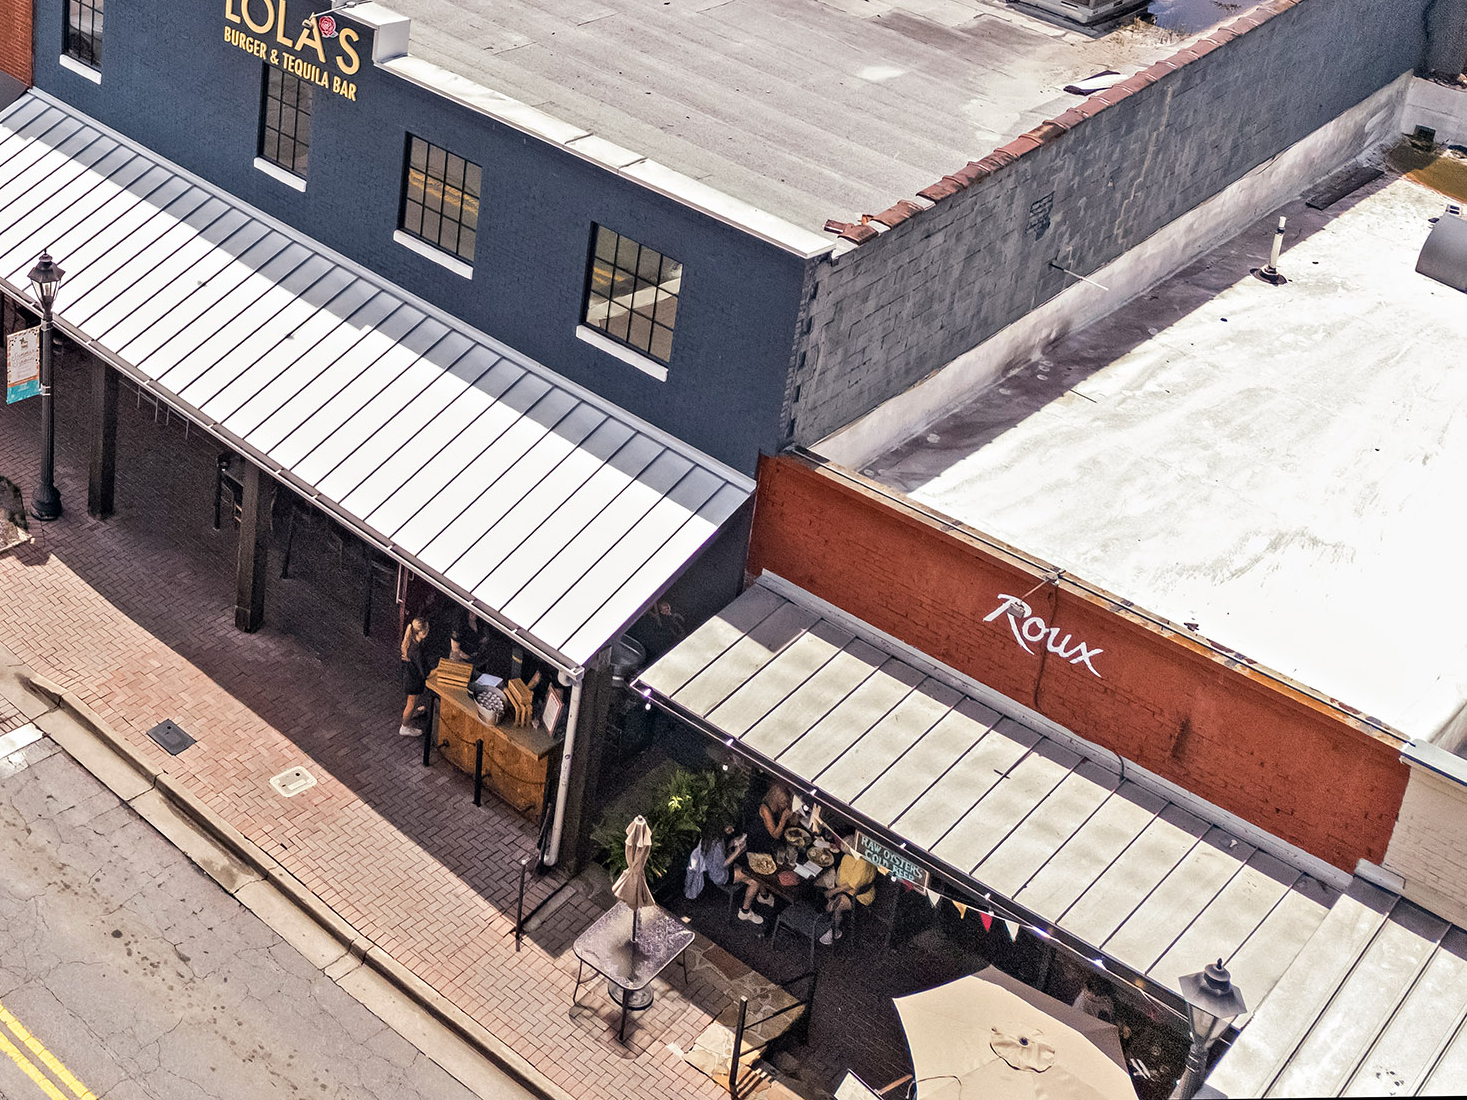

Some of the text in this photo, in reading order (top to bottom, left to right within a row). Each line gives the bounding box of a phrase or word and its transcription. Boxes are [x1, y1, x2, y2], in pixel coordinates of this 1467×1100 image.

[224, 26, 357, 102] BURGER & TEQUILA BAR
[982, 593, 1104, 677] Roux
[861, 836, 923, 879] RAW OYSTERS
